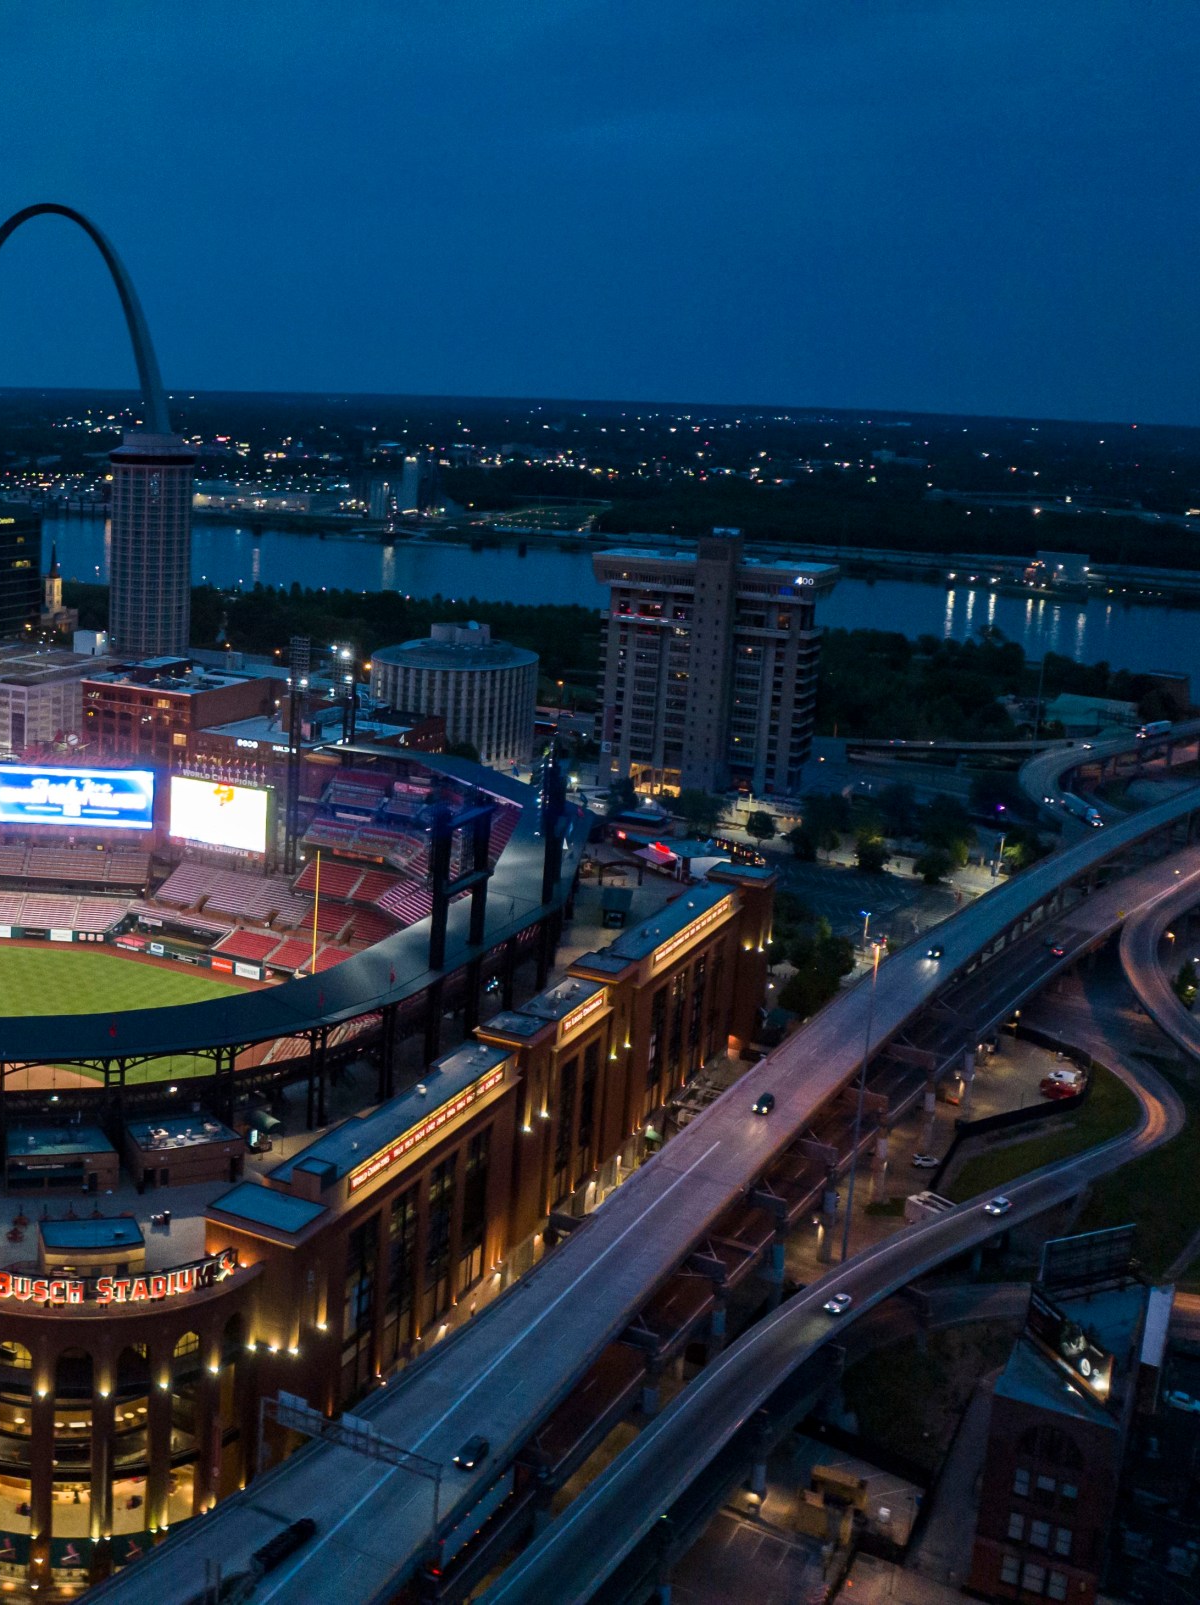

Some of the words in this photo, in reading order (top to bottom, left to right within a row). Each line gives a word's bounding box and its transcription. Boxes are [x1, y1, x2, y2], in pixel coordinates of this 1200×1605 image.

[183, 768, 210, 779] WORLD
[211, 774, 258, 787] CHAMPIONS
[96, 1262, 214, 1304] STADIUM
